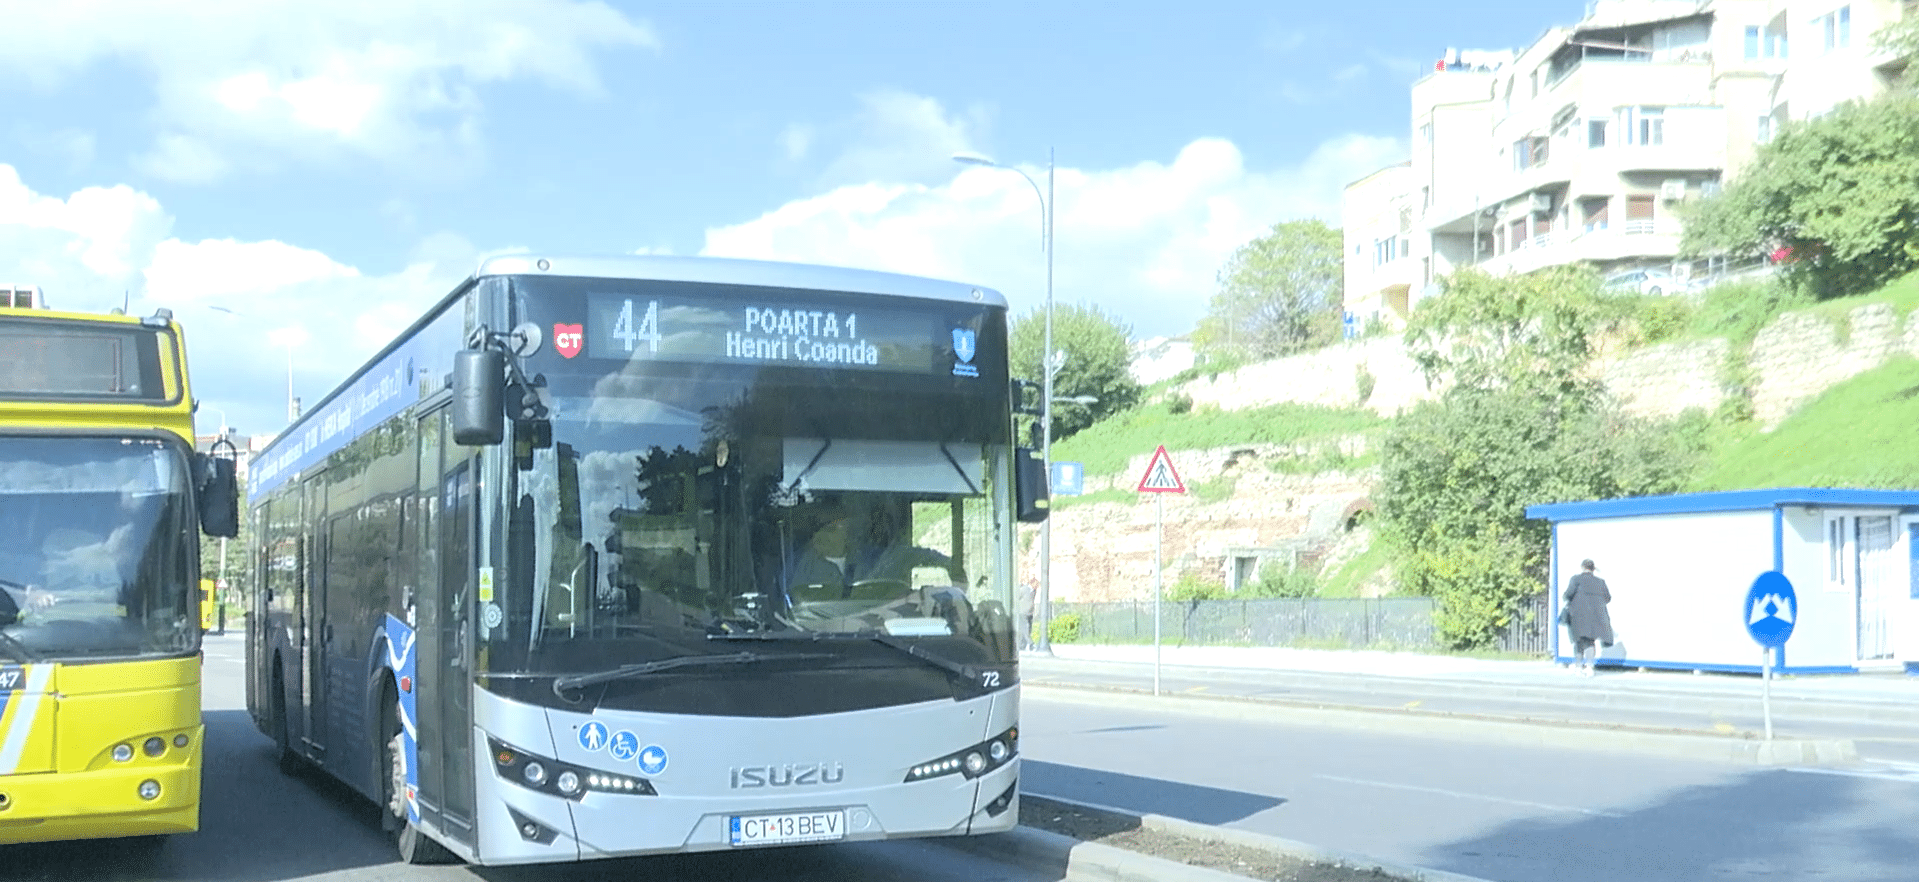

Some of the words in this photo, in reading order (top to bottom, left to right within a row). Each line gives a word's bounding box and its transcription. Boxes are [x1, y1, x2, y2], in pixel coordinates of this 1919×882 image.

[613, 298, 662, 352] 44
[745, 306, 840, 339] POARTA
[845, 312, 857, 340] 1
[556, 332, 582, 349] CT
[725, 331, 788, 360] Henri
[794, 335, 879, 366] Coanda
[0, 671, 20, 688] 47
[982, 671, 1000, 688] 72
[729, 761, 844, 789] ISUZU
[744, 818, 770, 839] CT
[776, 816, 795, 837] 13
[798, 814, 839, 836] BEV
